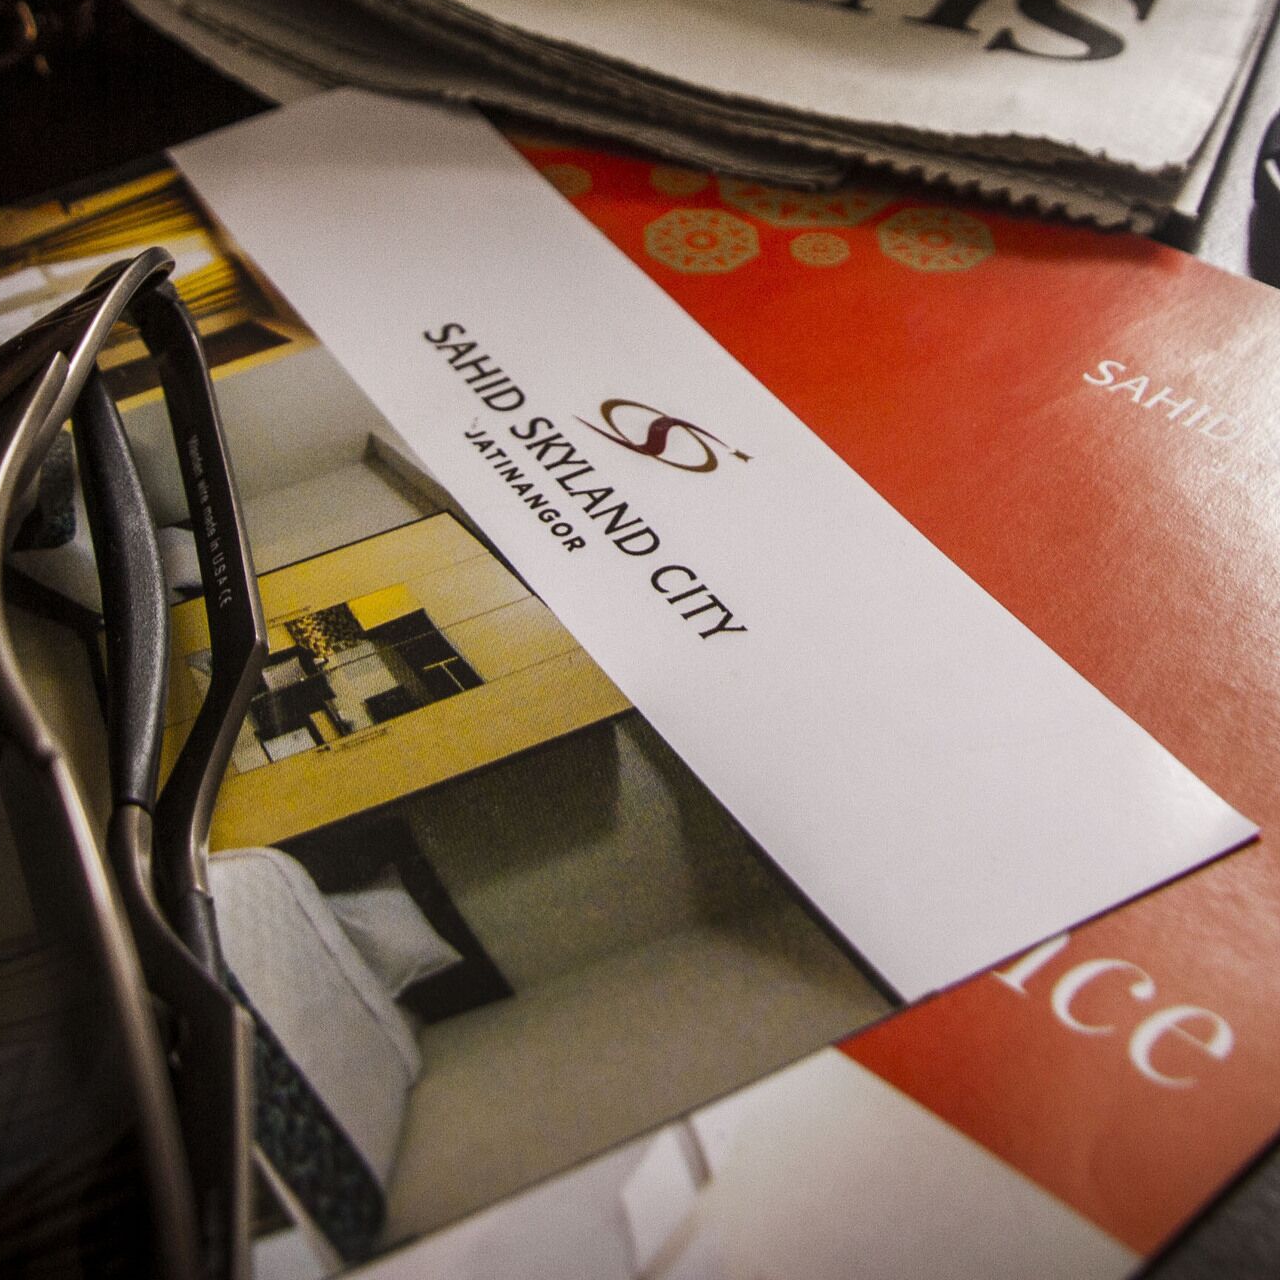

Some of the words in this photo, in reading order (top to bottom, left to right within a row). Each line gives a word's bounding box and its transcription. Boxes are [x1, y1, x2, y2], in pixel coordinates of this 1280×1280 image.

[1082, 359, 1244, 443] SAHID
[423, 322, 526, 412] SAHID
[509, 416, 661, 557] SKYLAND
[650, 564, 749, 641] CITY
[464, 426, 587, 554] JATINANGOR
